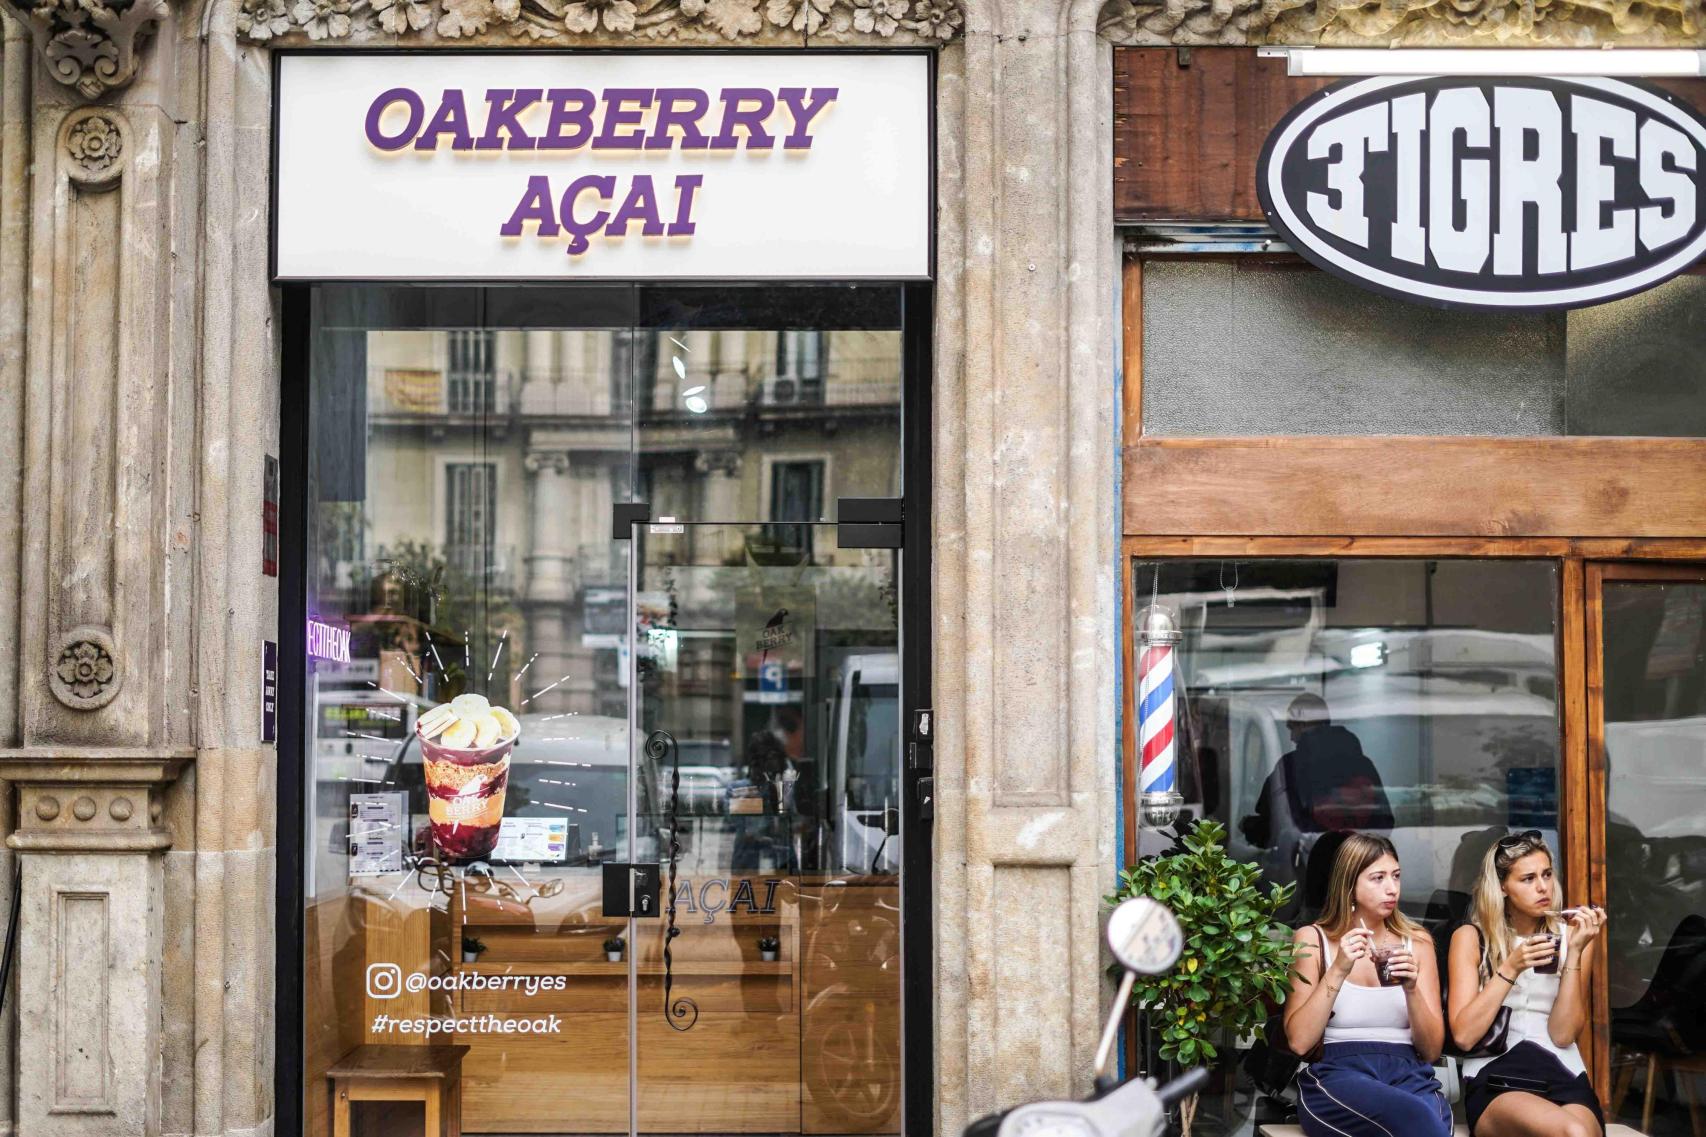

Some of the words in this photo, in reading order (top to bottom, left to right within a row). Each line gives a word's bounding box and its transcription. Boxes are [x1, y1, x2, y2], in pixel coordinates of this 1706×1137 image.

[364, 87, 839, 151] OAKBERRY
[500, 174, 703, 256] AÇAI
[756, 632, 793, 650] BERRY
[762, 624, 785, 640] OAK
[664, 879, 780, 924] AÇAI
[405, 971, 567, 996] @oakberryes
[371, 1014, 562, 1039] #respecttheoak
